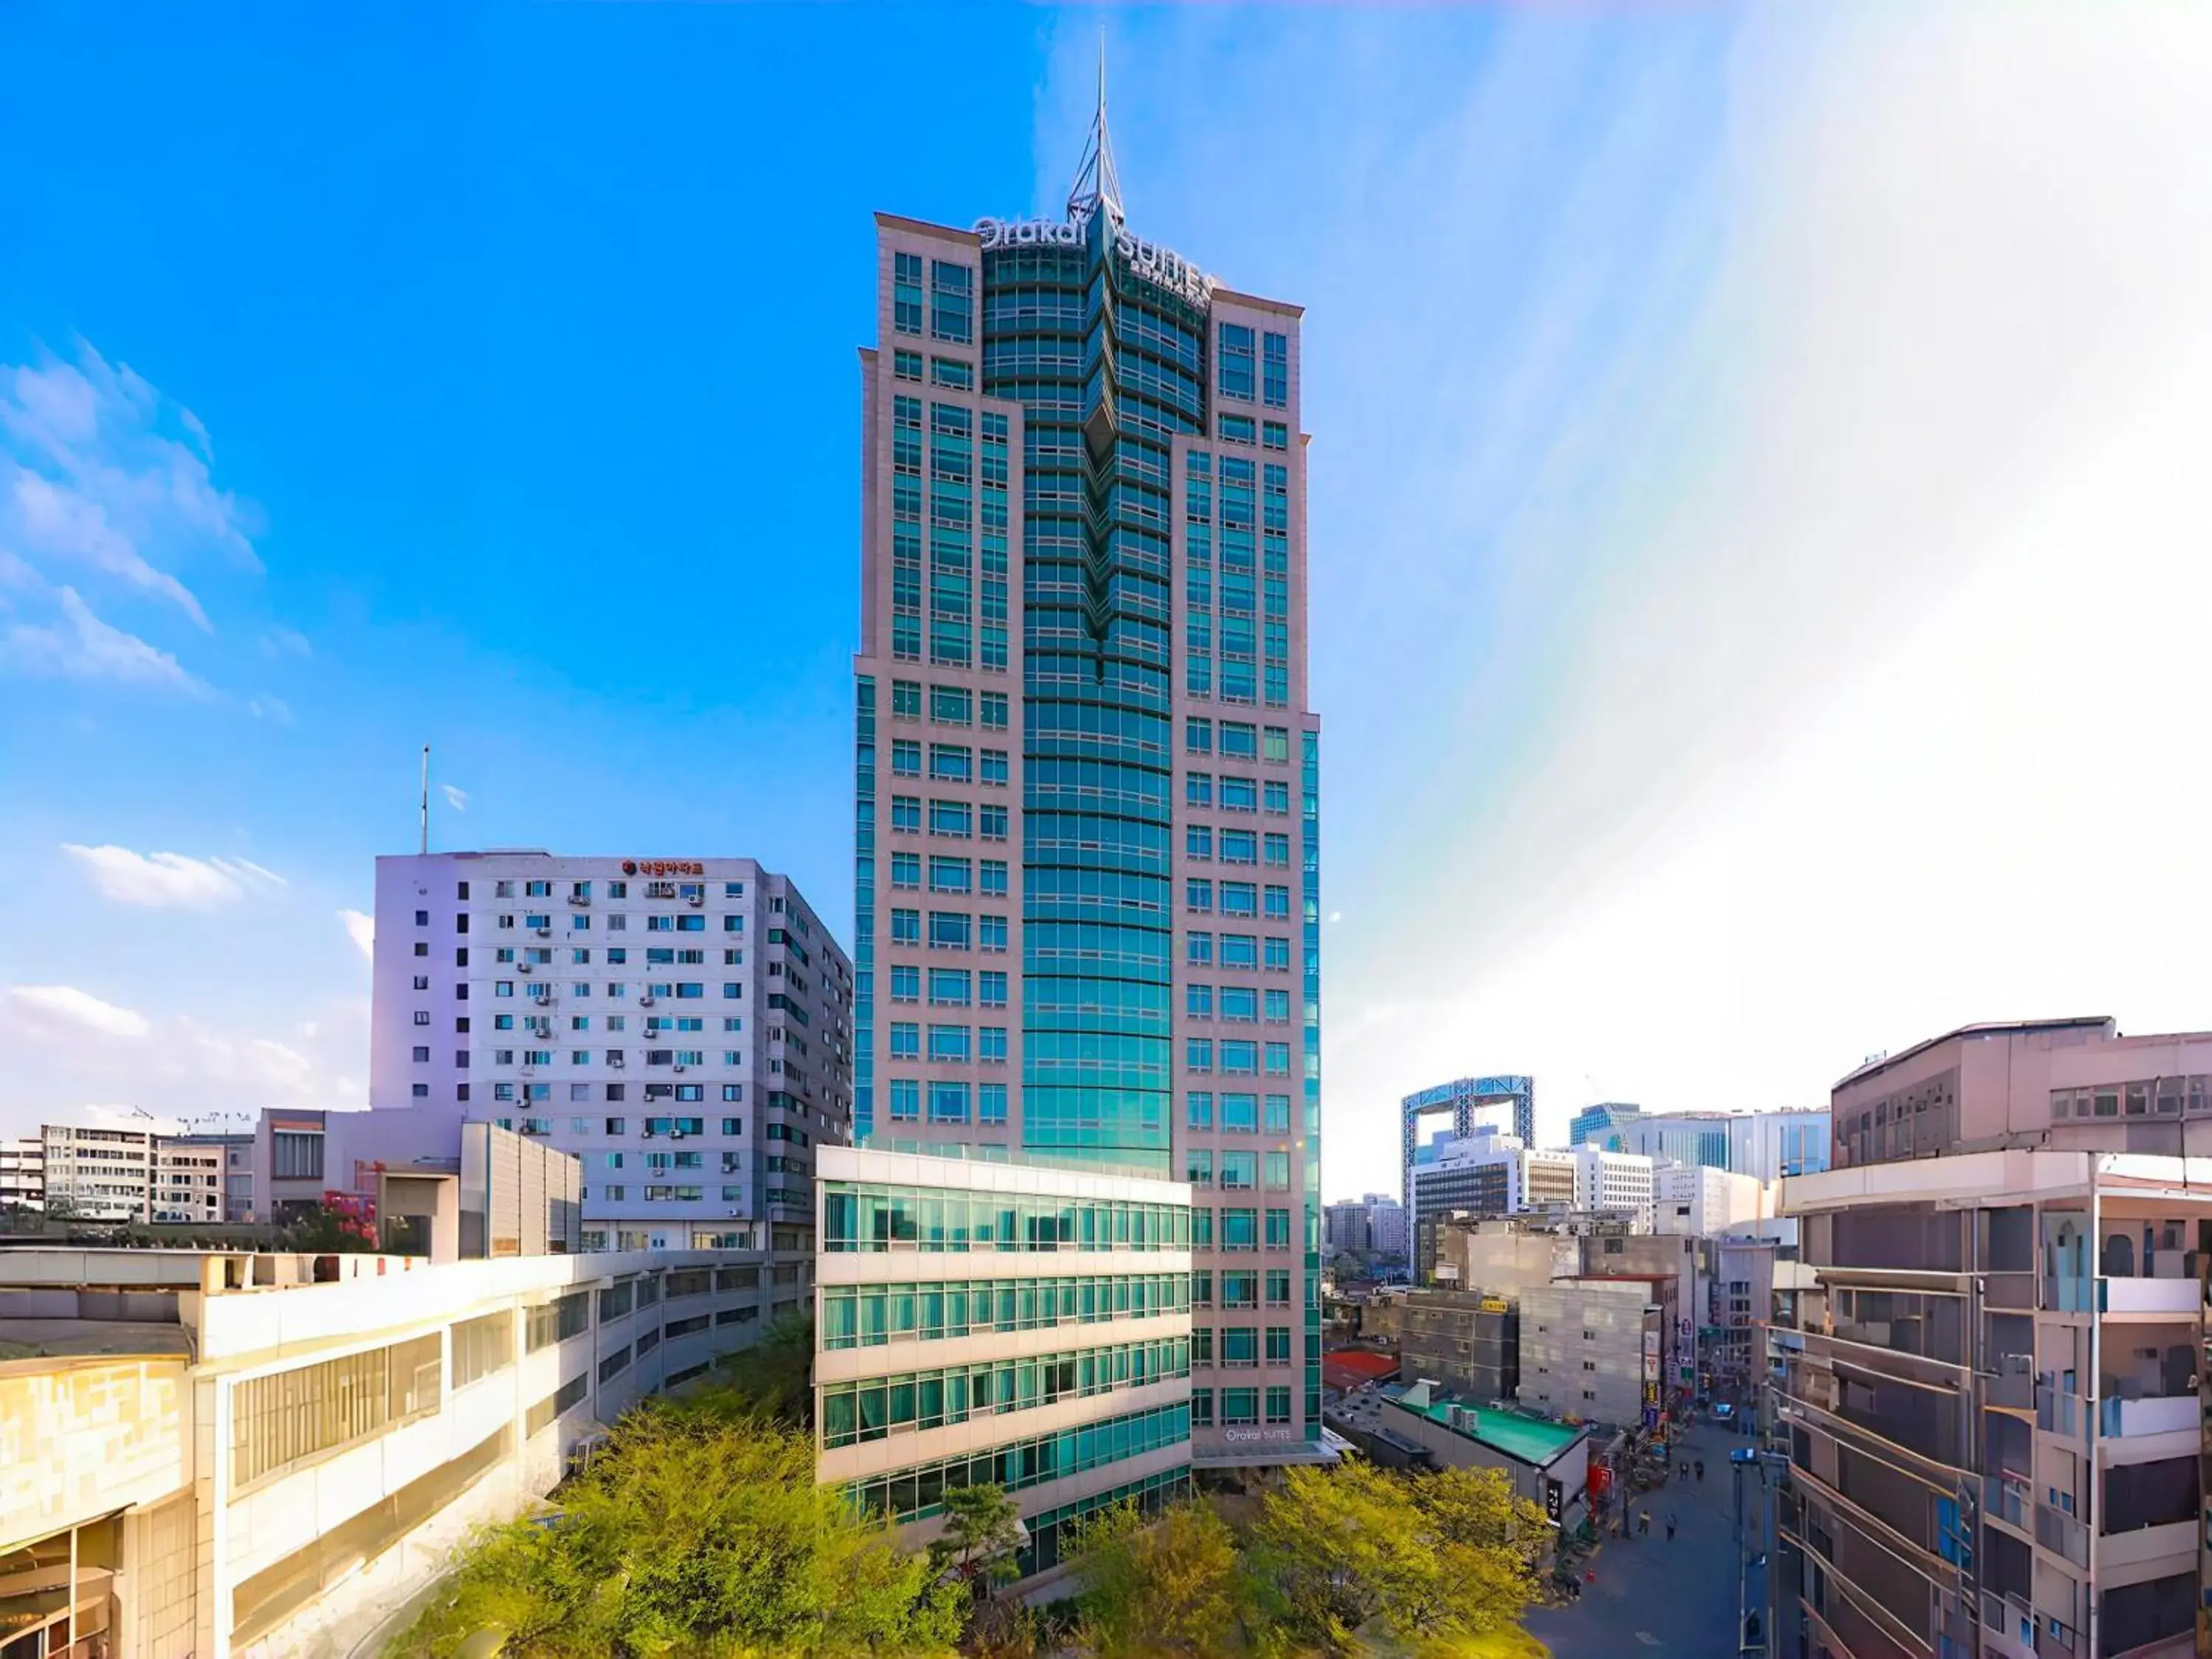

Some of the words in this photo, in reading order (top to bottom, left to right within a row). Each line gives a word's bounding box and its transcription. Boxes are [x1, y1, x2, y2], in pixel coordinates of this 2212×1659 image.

[975, 215, 1087, 248] Orakai
[1225, 1429, 1260, 1441] Orakai
[1263, 1430, 1292, 1440] SUITES
